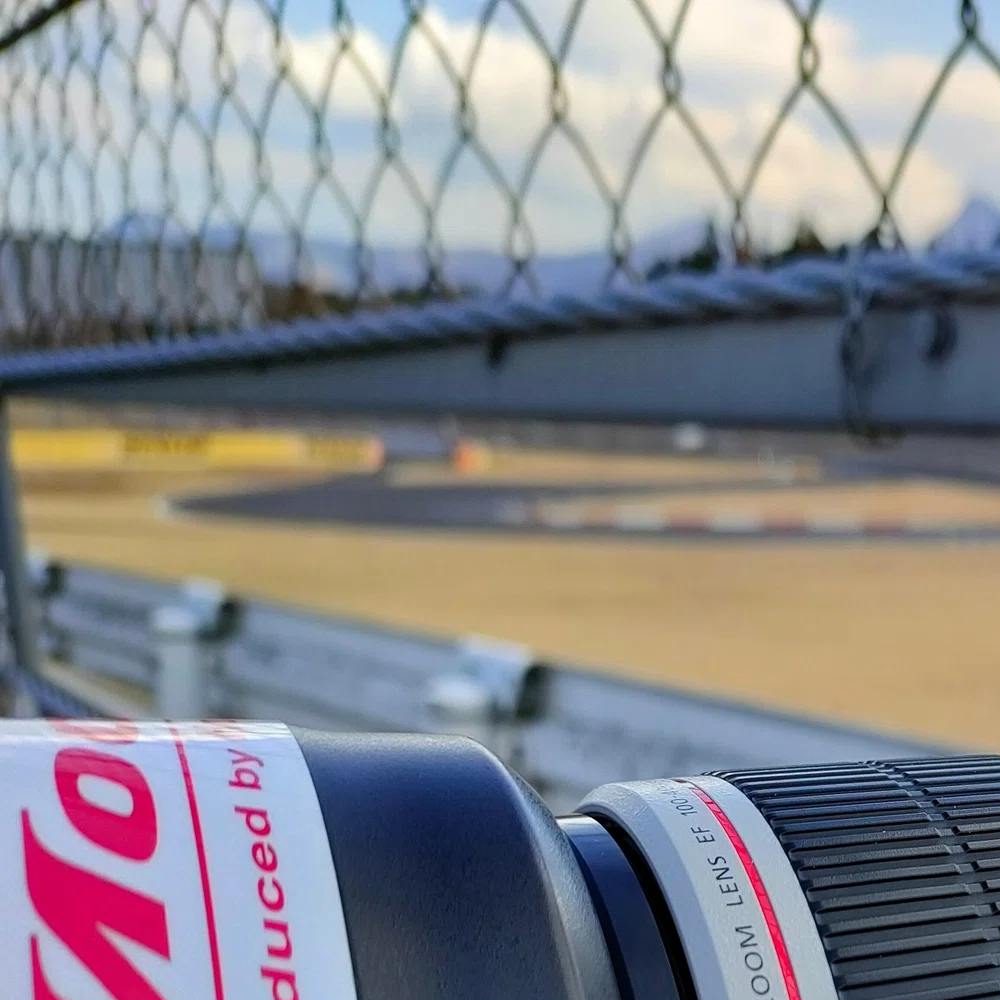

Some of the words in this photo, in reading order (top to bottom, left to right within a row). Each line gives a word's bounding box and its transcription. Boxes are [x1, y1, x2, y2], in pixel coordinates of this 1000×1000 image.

[226, 747, 265, 791] by
[690, 825, 716, 844] EF
[706, 855, 744, 907] LENS
